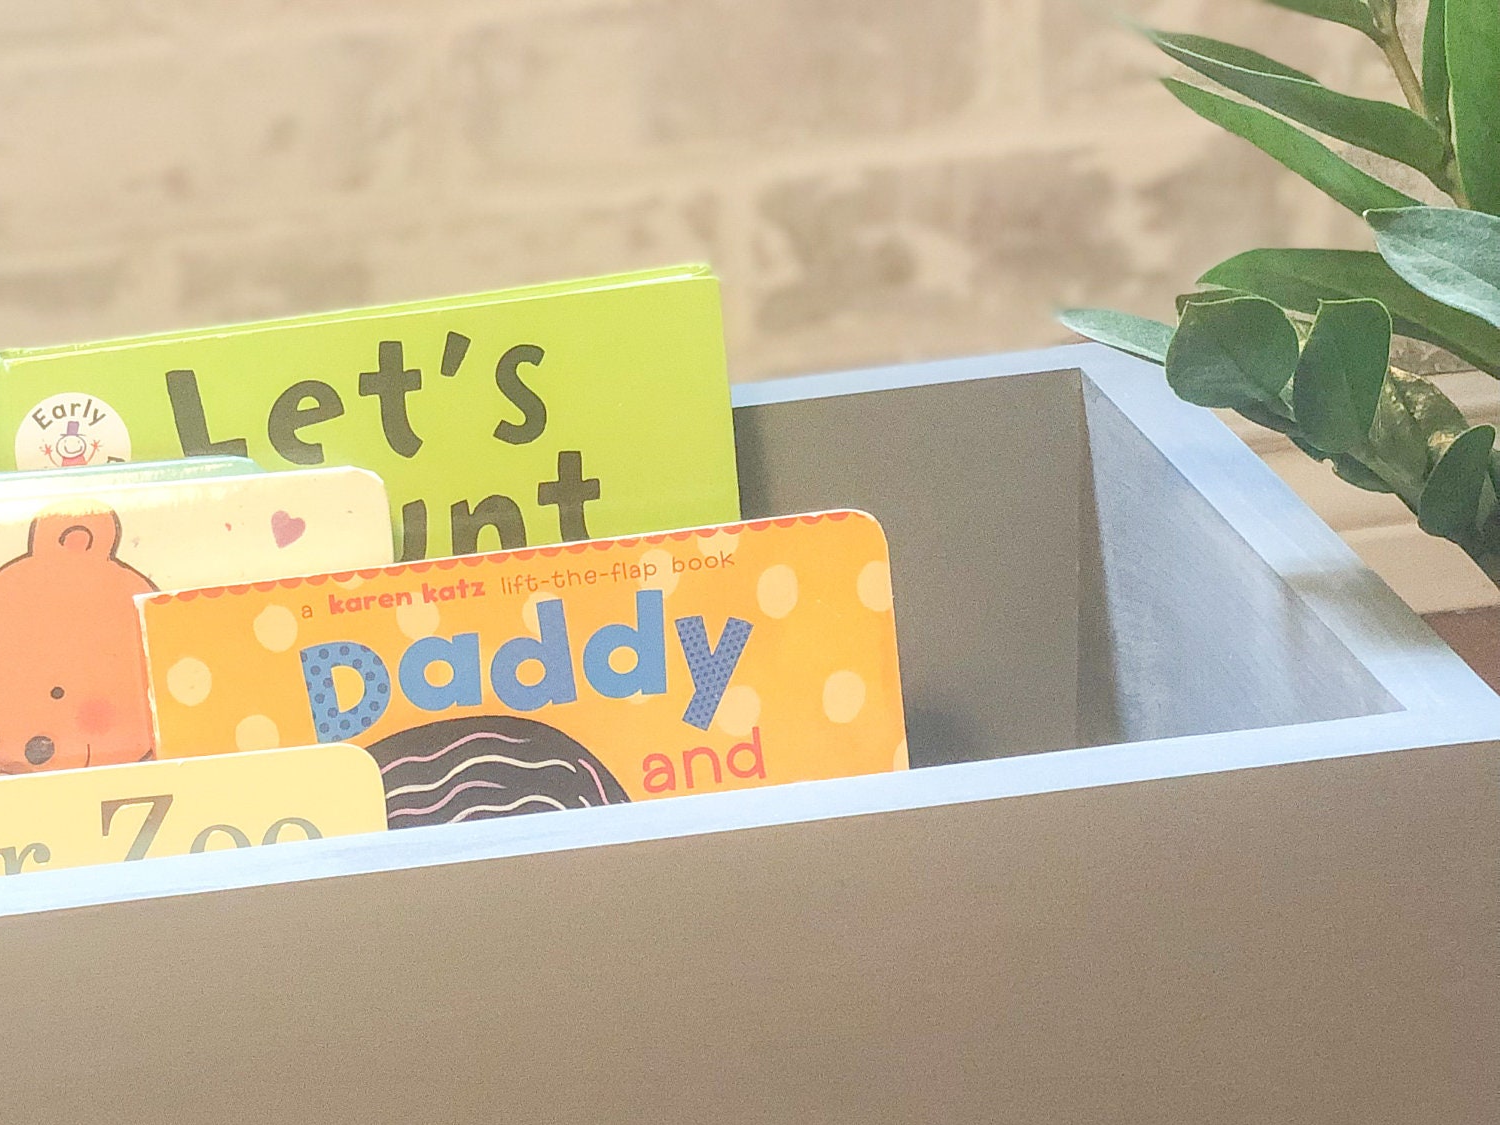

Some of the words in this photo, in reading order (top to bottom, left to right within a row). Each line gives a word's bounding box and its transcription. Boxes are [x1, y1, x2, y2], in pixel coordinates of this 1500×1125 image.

[32, 399, 106, 430] Early
[164, 331, 547, 466] Let's
[301, 604, 314, 619] a
[328, 591, 412, 615] karen
[422, 579, 486, 603] katz
[500, 560, 657, 595] lift-the-flap
[671, 551, 735, 572] book
[300, 590, 753, 745] Daddy
[641, 726, 768, 793] and
